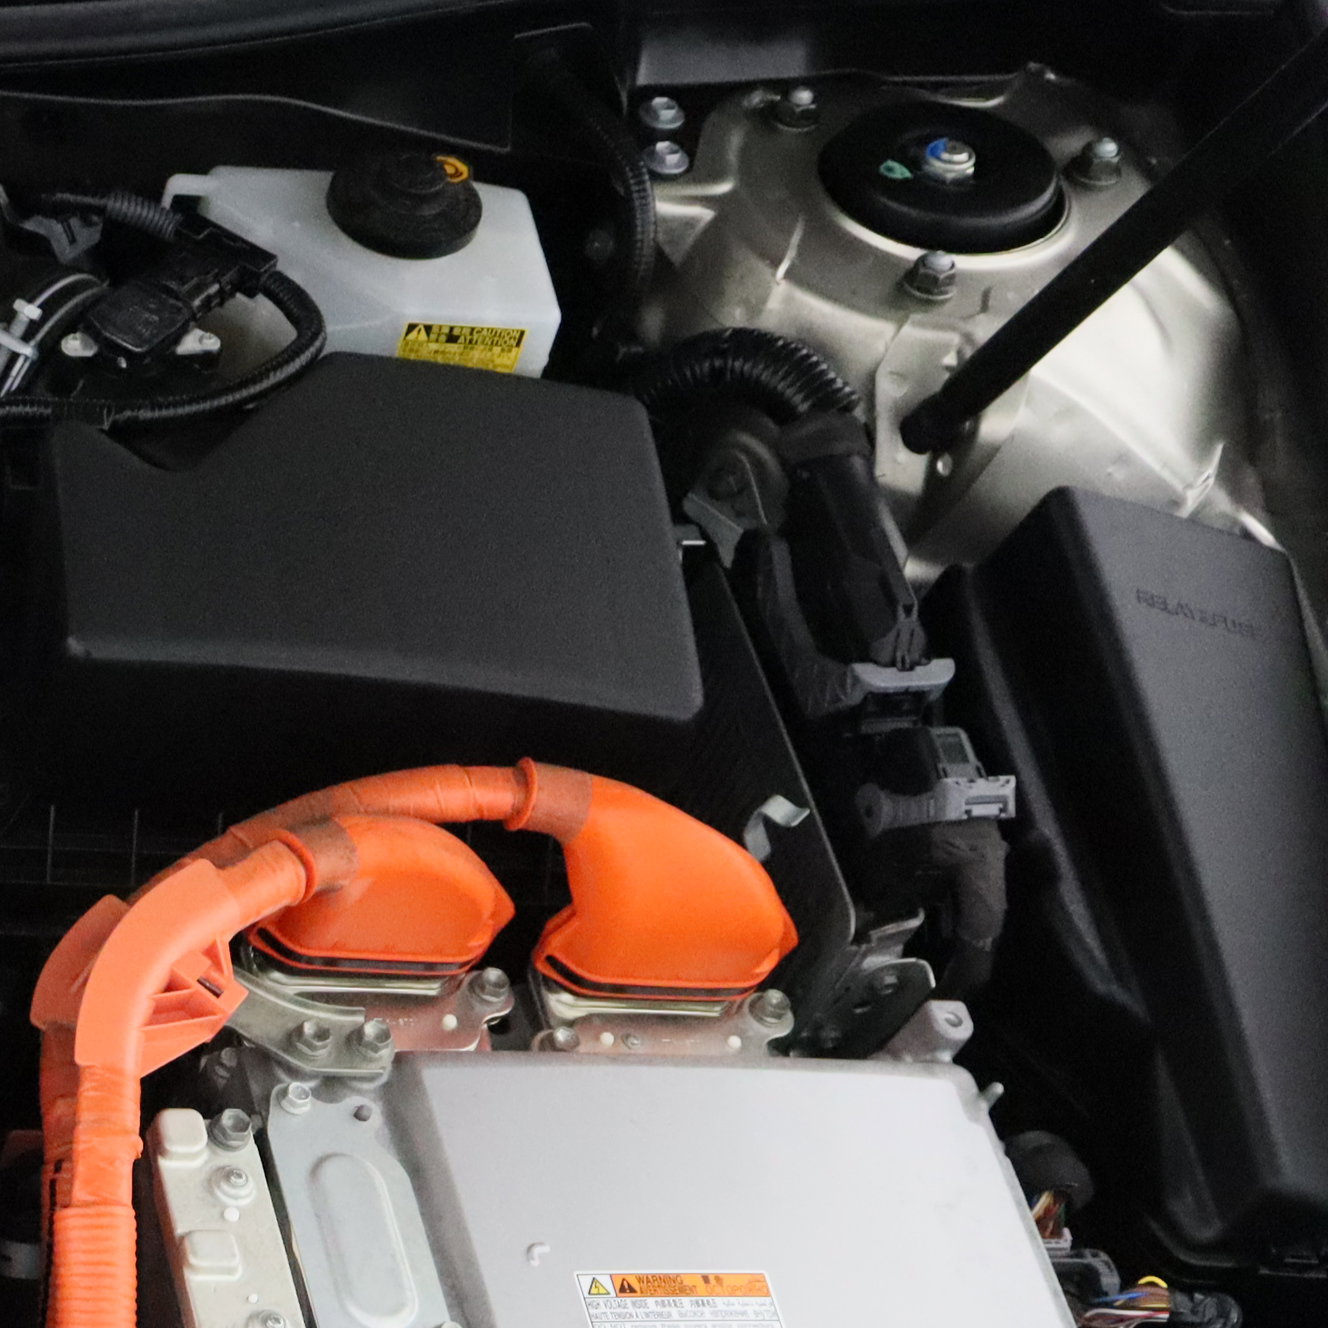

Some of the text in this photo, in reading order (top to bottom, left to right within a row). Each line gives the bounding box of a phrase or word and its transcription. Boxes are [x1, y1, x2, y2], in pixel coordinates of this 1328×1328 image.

[473, 327, 521, 337] CAUTION
[457, 335, 518, 346] ATTENTION
[635, 1275, 684, 1286] WARNING
[639, 1284, 698, 1296] AVERTISSEMENT
